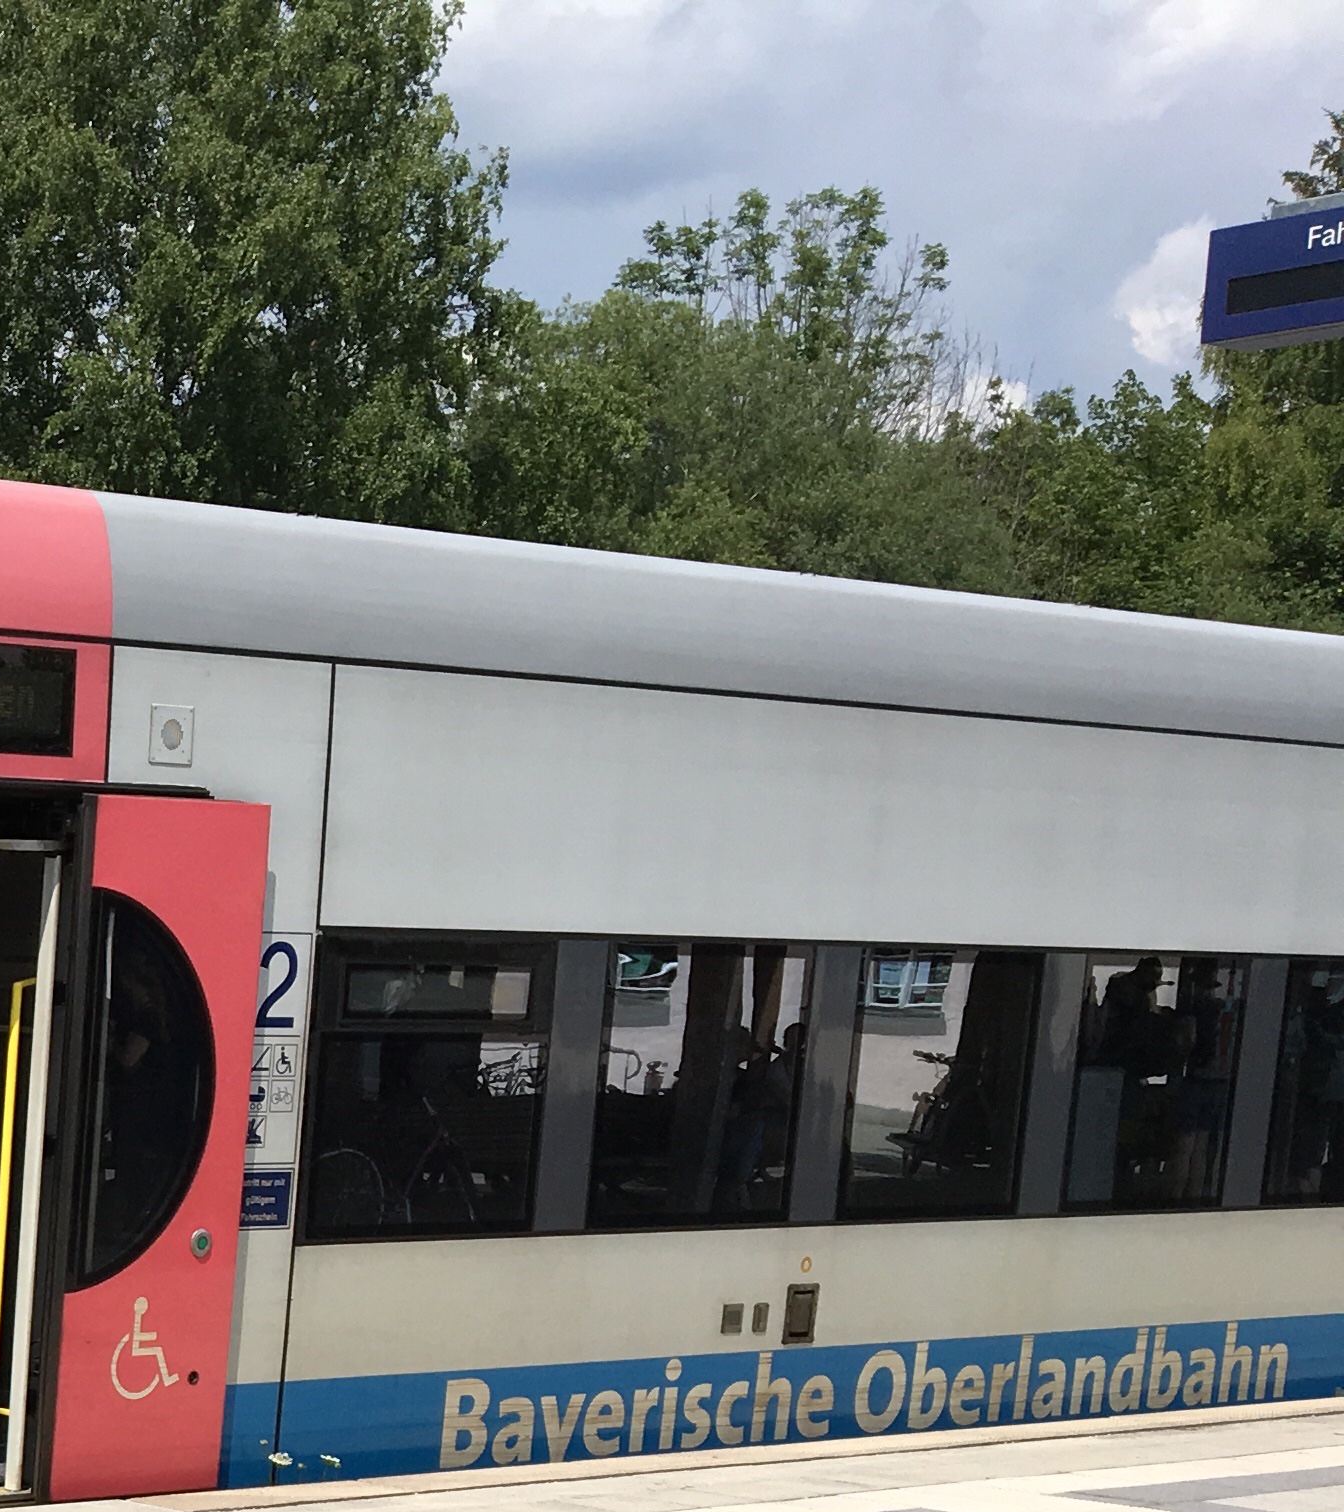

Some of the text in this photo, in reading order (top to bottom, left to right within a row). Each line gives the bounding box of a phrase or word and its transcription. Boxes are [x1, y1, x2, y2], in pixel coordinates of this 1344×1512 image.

[255, 940, 299, 1028] 2
[439, 1322, 1290, 1470] Bayerische Oberlandbahn
